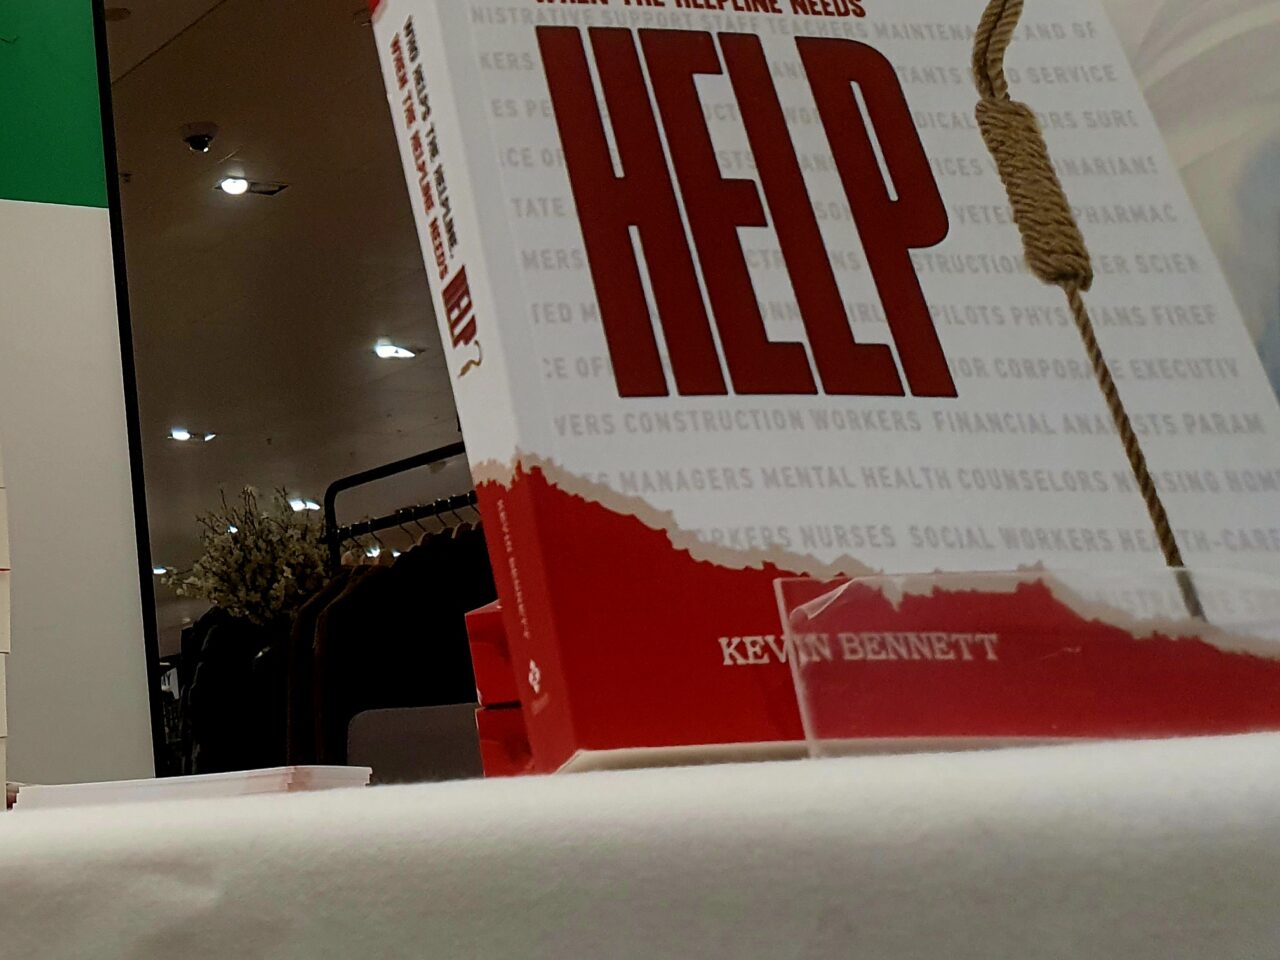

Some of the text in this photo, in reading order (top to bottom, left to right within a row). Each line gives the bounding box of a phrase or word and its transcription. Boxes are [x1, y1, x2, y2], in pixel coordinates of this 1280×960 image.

[625, 409, 1051, 435] CONSTRUCTION WORKERS FINANCIAL
[619, 467, 1108, 494] MANAGERS MENTAL HEALTH COUNSELORS
[800, 525, 896, 549] NURSES
[909, 526, 995, 549] SOCIAL
[838, 632, 999, 661] BENNETT
